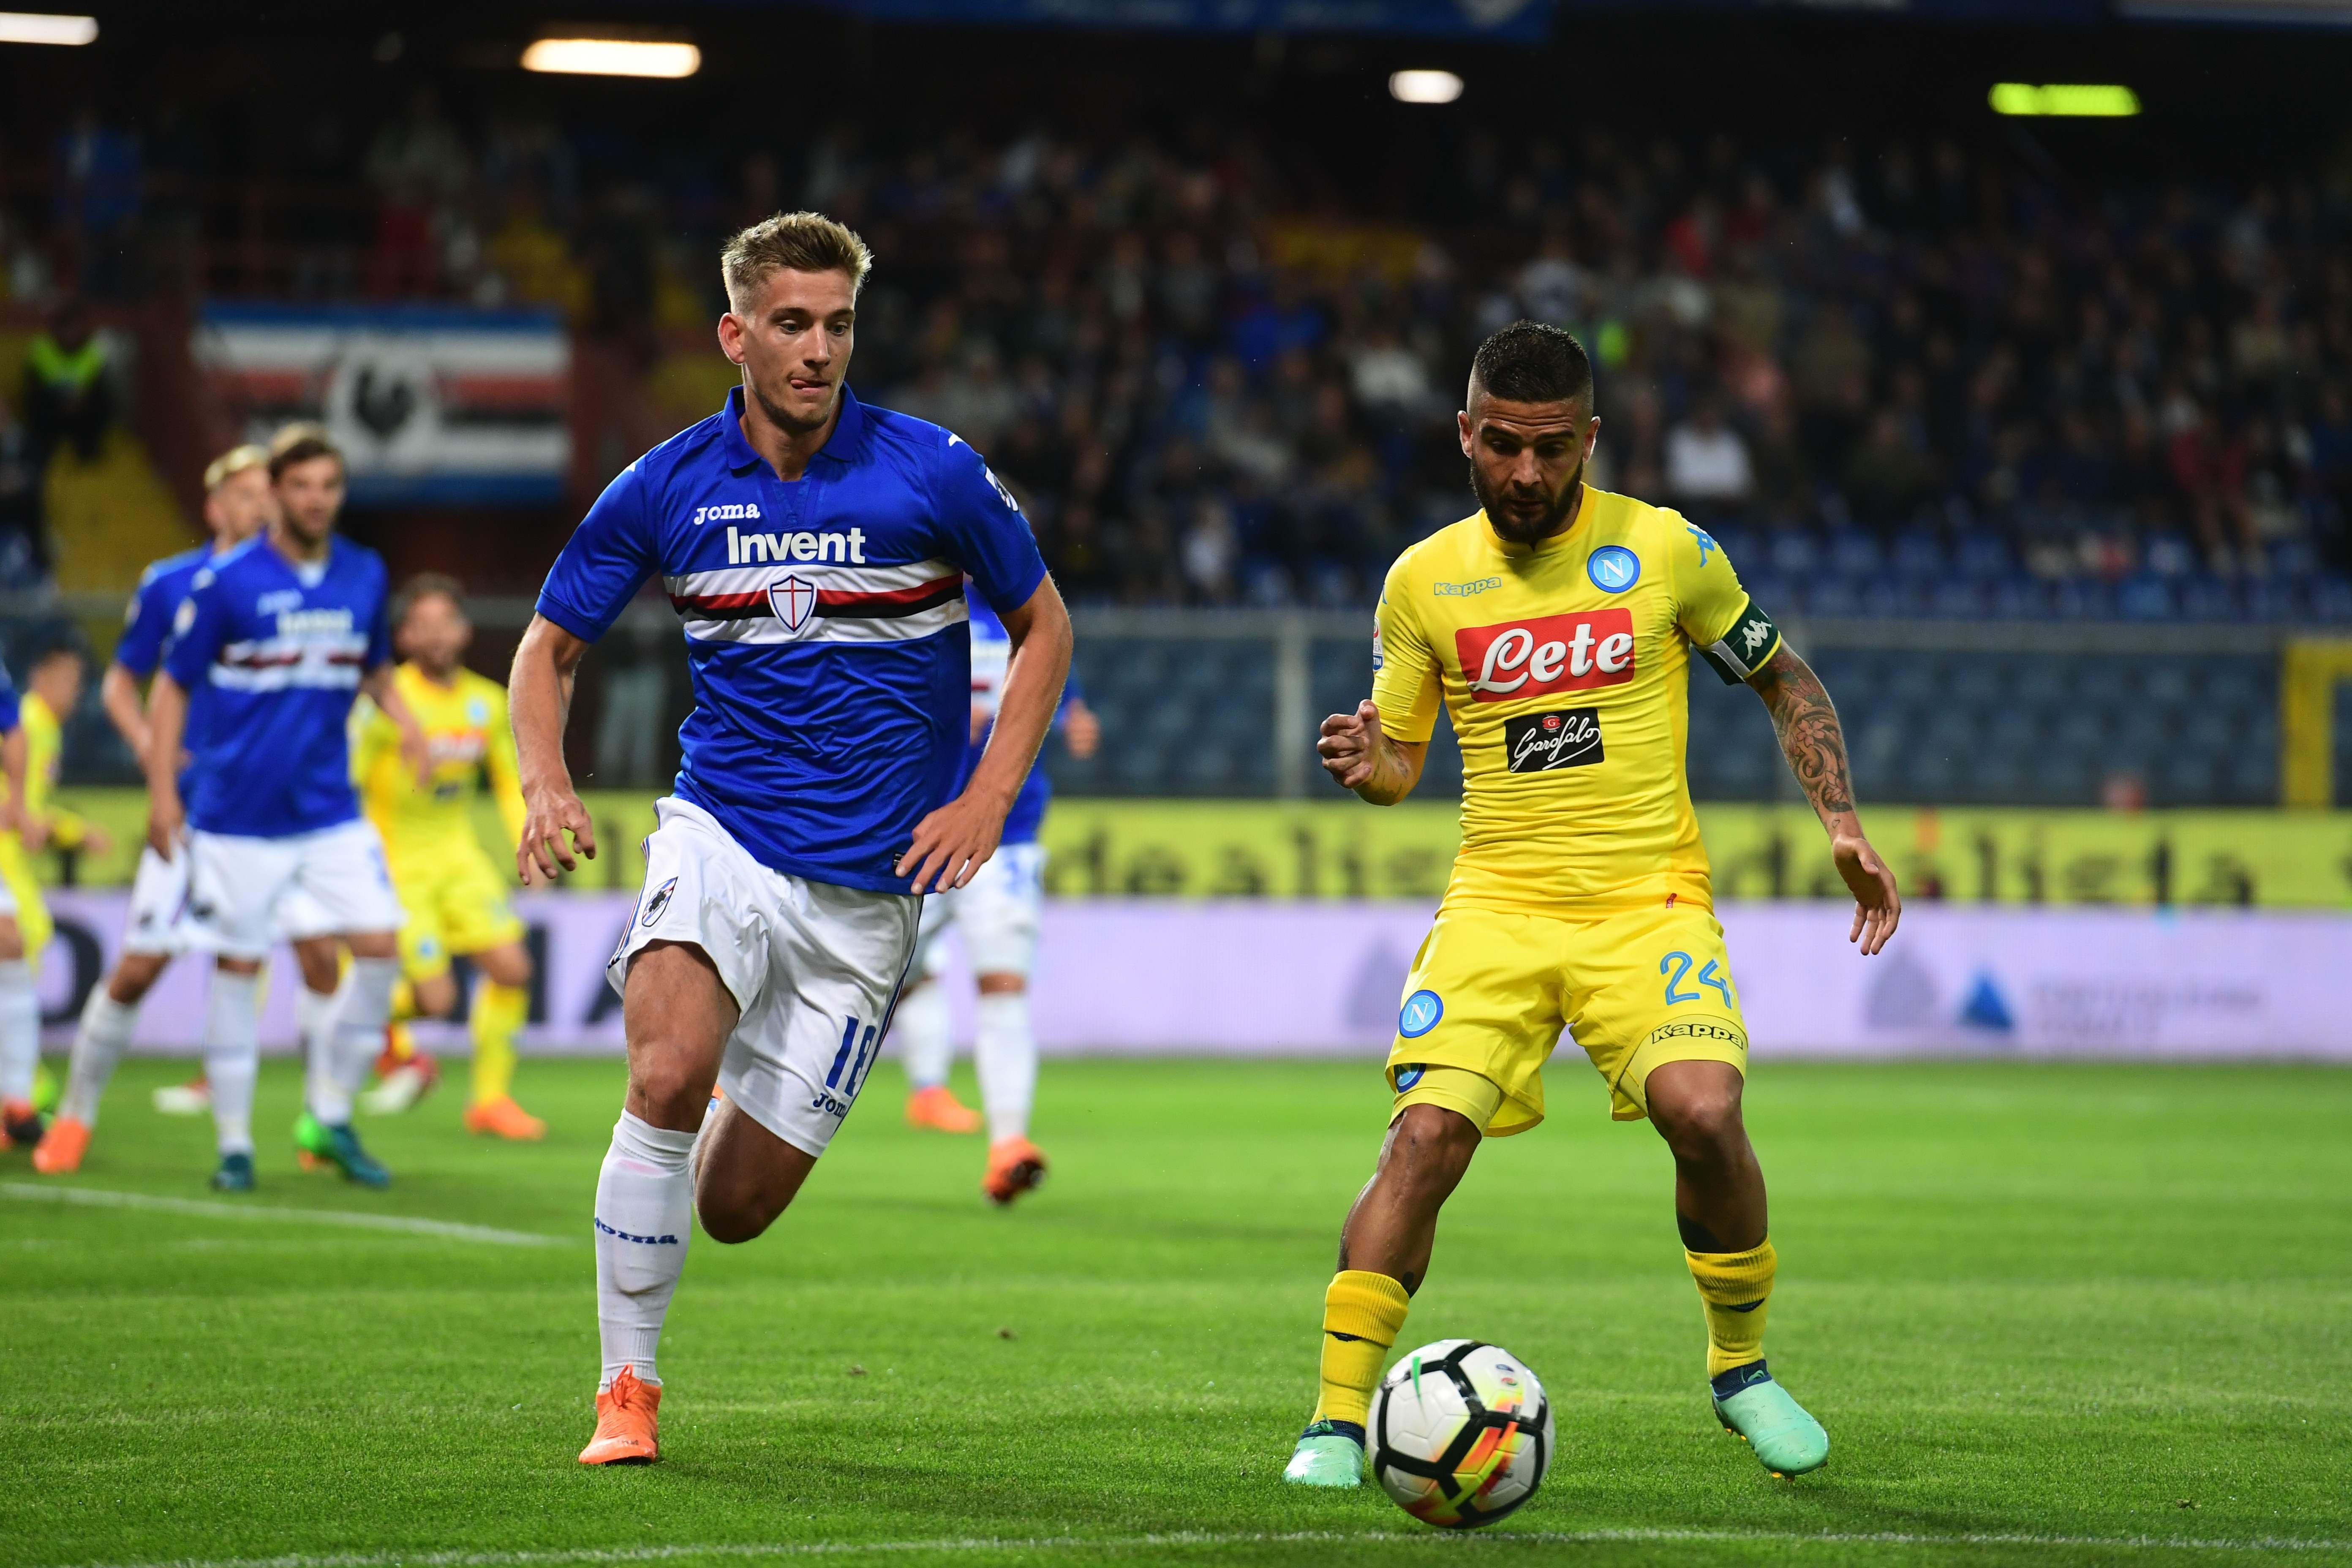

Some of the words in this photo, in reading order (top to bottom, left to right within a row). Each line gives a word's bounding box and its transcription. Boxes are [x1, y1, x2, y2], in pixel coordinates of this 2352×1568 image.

[694, 503, 760, 525] Joma
[727, 526, 866, 564] Invent
[1601, 558, 1624, 581] N
[1434, 577, 1501, 597] Kappa
[1467, 623, 1633, 693] Lete
[1509, 716, 1601, 773] Garofalo
[1660, 951, 1733, 1010] 24
[1407, 1002, 1431, 1026] N
[1652, 1024, 1743, 1050] Kappa
[813, 1092, 847, 1118] Jom
